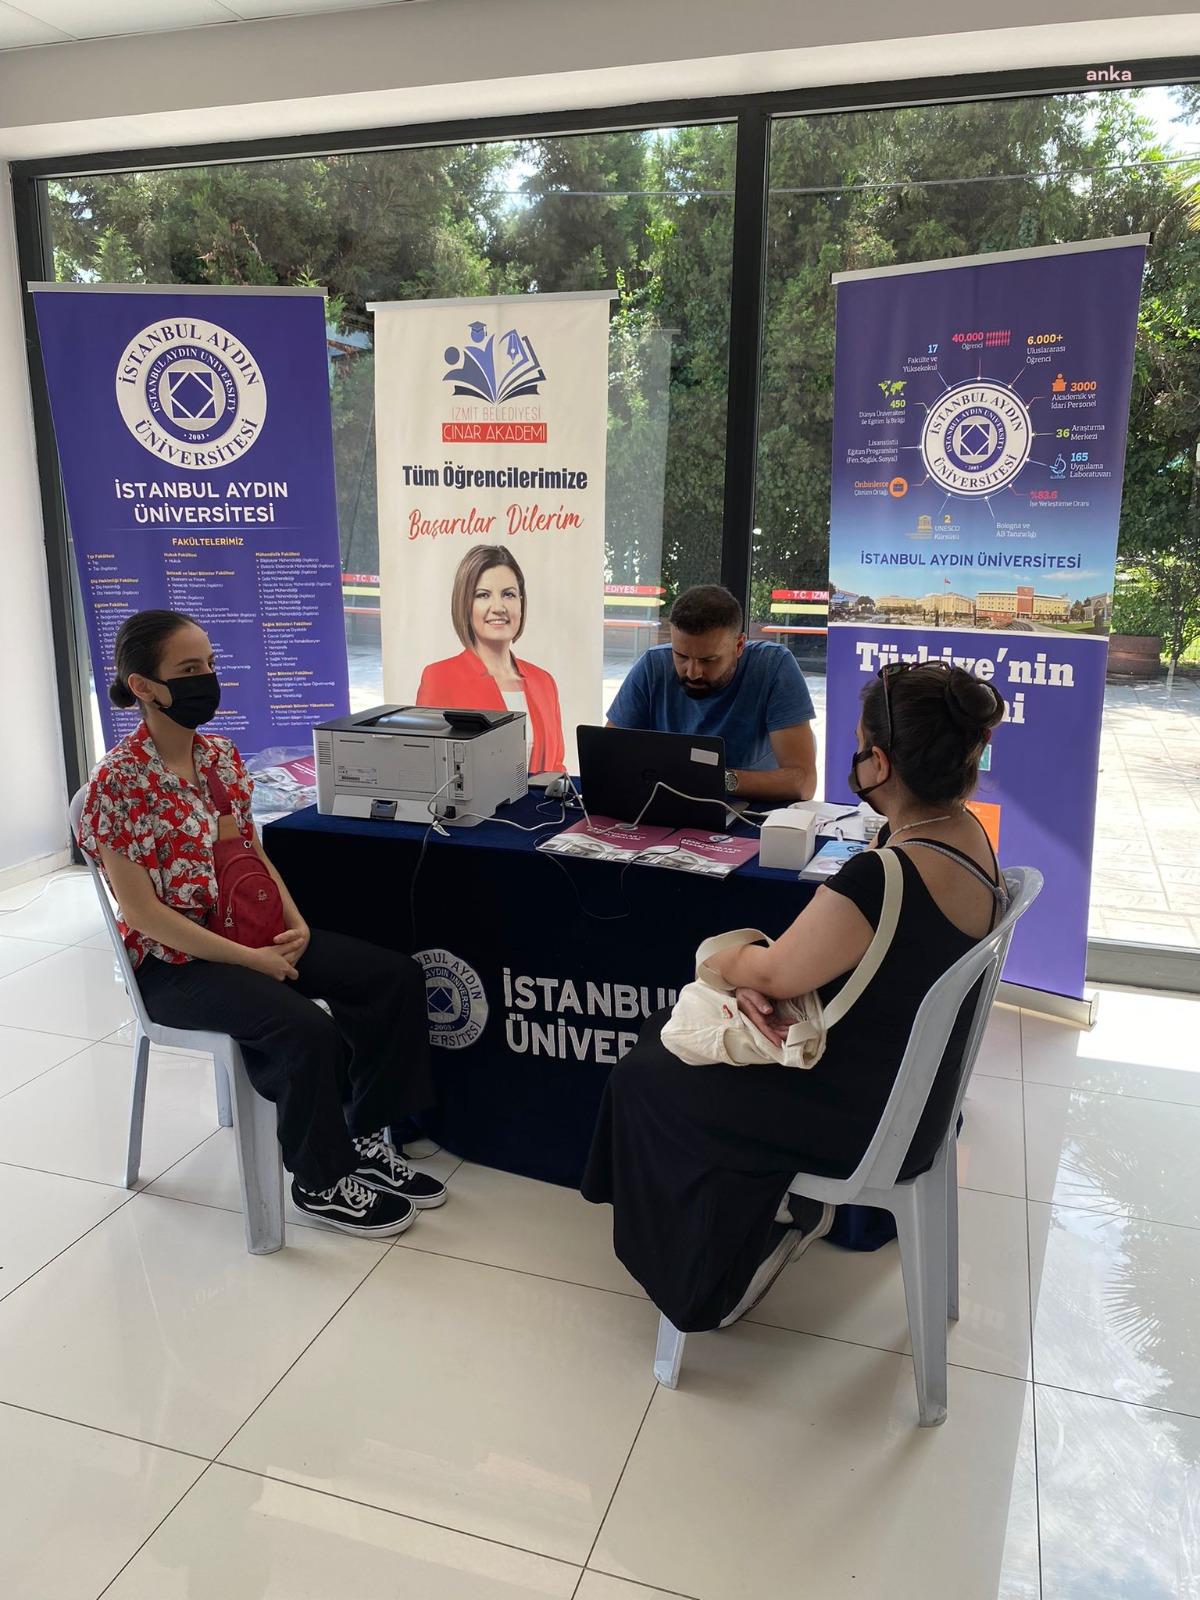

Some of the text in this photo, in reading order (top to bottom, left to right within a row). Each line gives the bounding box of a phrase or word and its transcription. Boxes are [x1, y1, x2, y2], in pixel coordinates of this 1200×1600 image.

[952, 332, 984, 343] 40.000
[1027, 334, 1063, 345] 6.000+
[928, 344, 938, 354] 17
[1027, 345, 1066, 354] Uluslararası
[119, 324, 260, 386] İSTANBUL AYDIN
[166, 349, 199, 362] AYDIN
[200, 351, 236, 414] UNIVERSITY
[1070, 381, 1097, 392] 3000
[1052, 393, 1087, 402] Akademik
[889, 399, 906, 409] 450
[1067, 400, 1097, 409] Personel
[929, 392, 1024, 434] İSTANBUL AYDIN
[962, 408, 983, 419] AYDIN
[1056, 429, 1070, 439] 36
[1072, 424, 1105, 433] Araştırma
[134, 418, 259, 466] ÜNİVERSİTESİ
[1071, 433, 1098, 441] Merkezi
[1070, 452, 1089, 462] 165
[933, 454, 1018, 488] ÜNİVERSİTESİ
[1071, 463, 1104, 472] Uygulama
[403, 461, 588, 490] Tüm Öğrencilerimize
[115, 478, 288, 499] İSTANBUL AYDIN
[134, 502, 275, 523] ÜNİVERSİTESİ
[408, 503, 585, 540] Başarılar Dilerim
[945, 515, 952, 523] 2
[996, 522, 1021, 531] Bologna
[172, 538, 245, 547] FAKÜLTELERİMİZ
[860, 551, 1081, 569] İSTANBUL AYDIN ÜNİVERSİTESİ
[793, 591, 810, 600] T.C.
[416, 953, 482, 1000] BUL AYDIN
[504, 1013, 640, 1064] ÜNİVER
